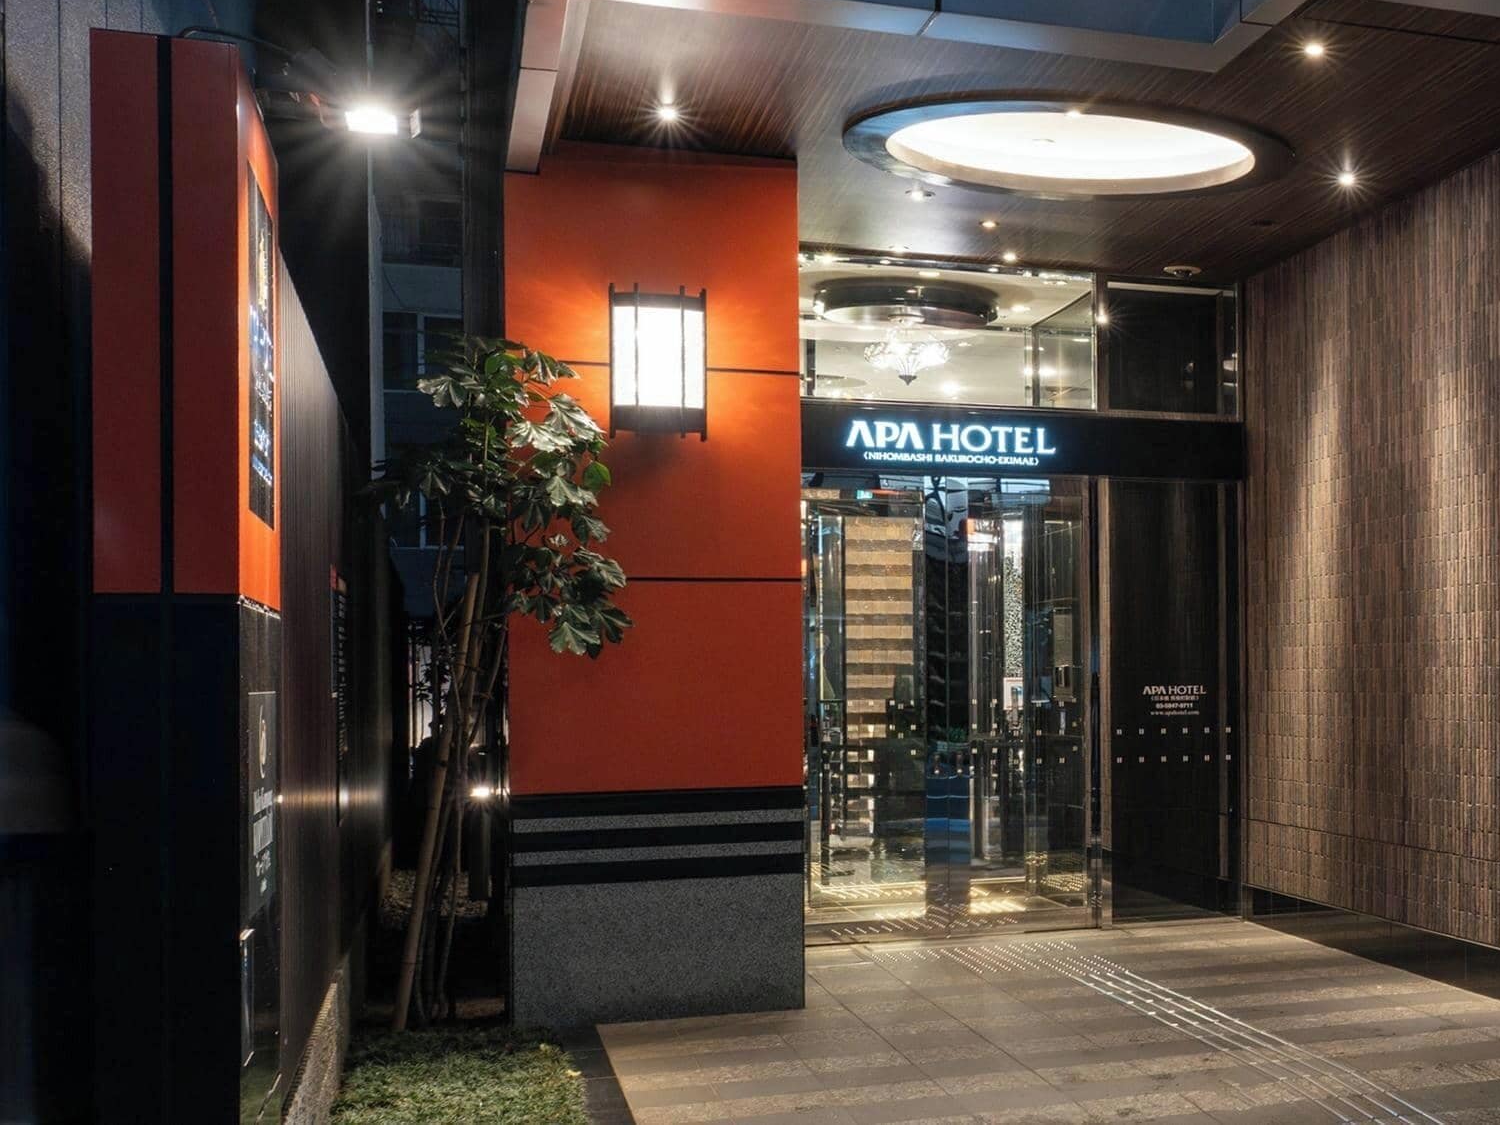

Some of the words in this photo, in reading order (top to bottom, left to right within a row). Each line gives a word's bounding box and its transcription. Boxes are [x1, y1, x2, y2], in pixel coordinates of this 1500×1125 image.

[845, 419, 925, 451] APA
[930, 423, 1058, 455] HOTEL
[1143, 686, 1167, 695] APA
[1169, 685, 1207, 694] HOTEL
